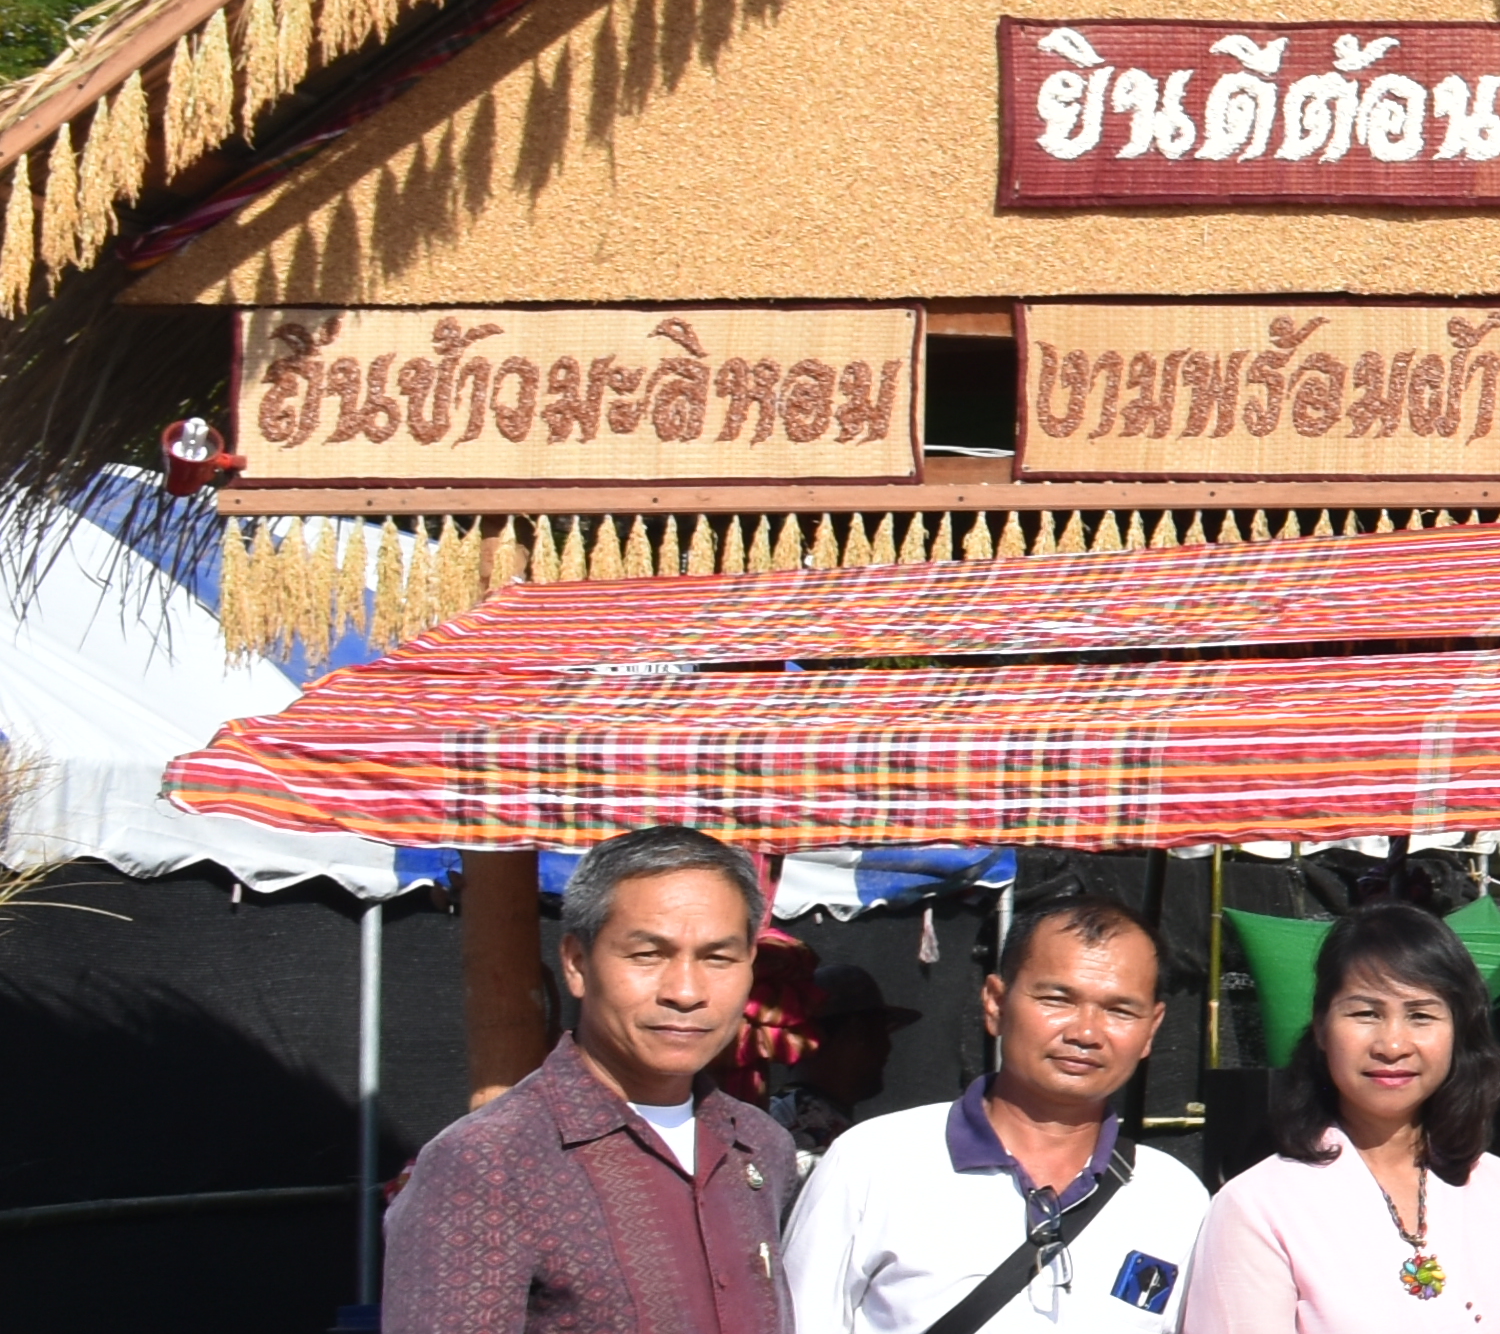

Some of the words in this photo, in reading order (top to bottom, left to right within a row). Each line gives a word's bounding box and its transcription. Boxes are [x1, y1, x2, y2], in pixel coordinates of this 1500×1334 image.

[258, 313, 902, 448] ถิ่นข้าวมะลิหอม
